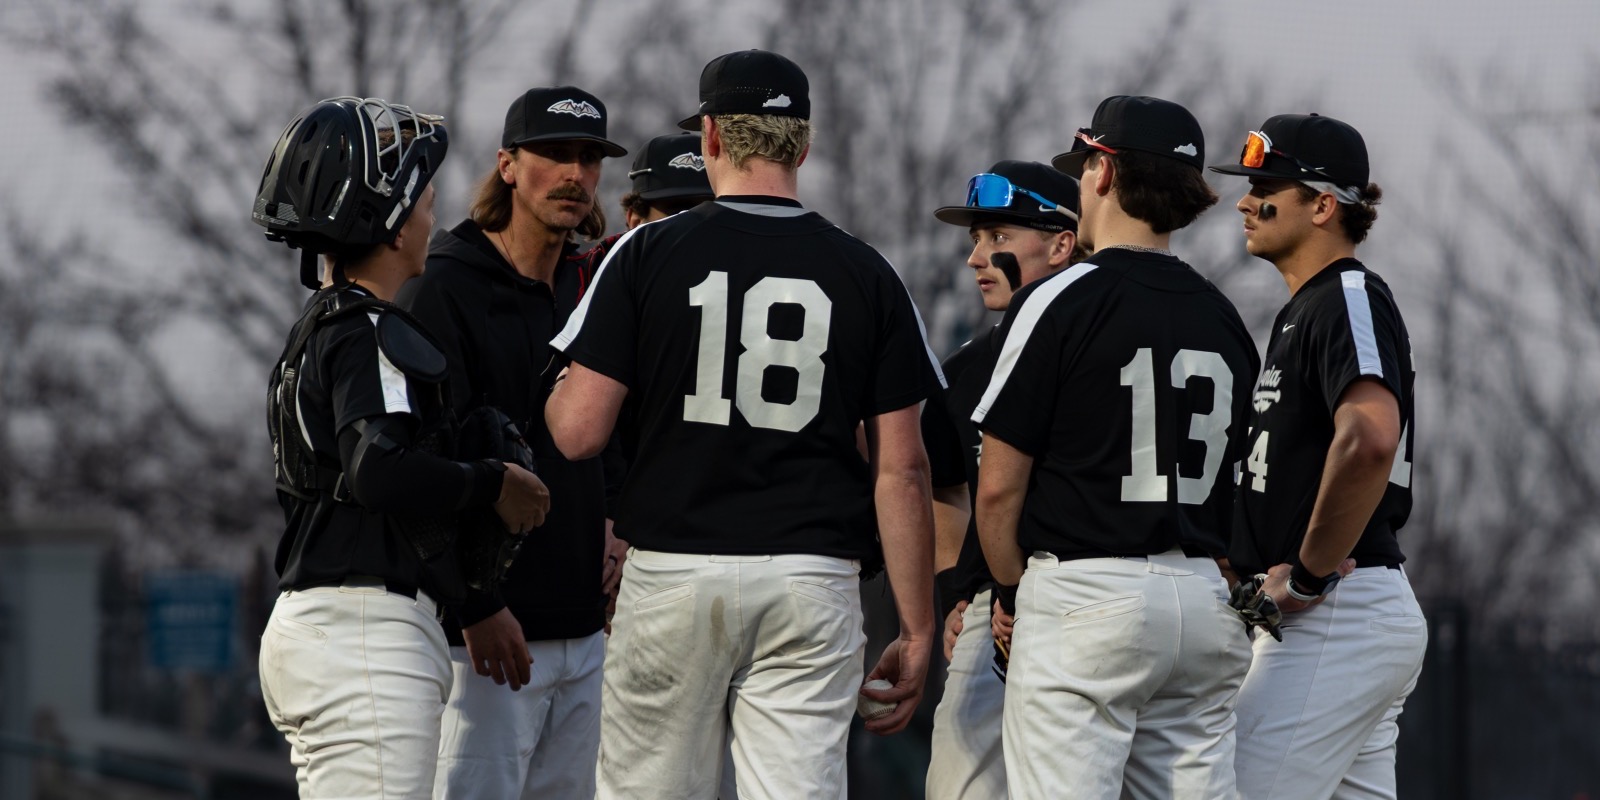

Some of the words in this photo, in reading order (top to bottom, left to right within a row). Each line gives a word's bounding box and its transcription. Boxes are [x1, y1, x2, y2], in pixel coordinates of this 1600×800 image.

[683, 270, 833, 433] 18
[1120, 348, 1234, 505] 13
[1234, 426, 1270, 494] 4
